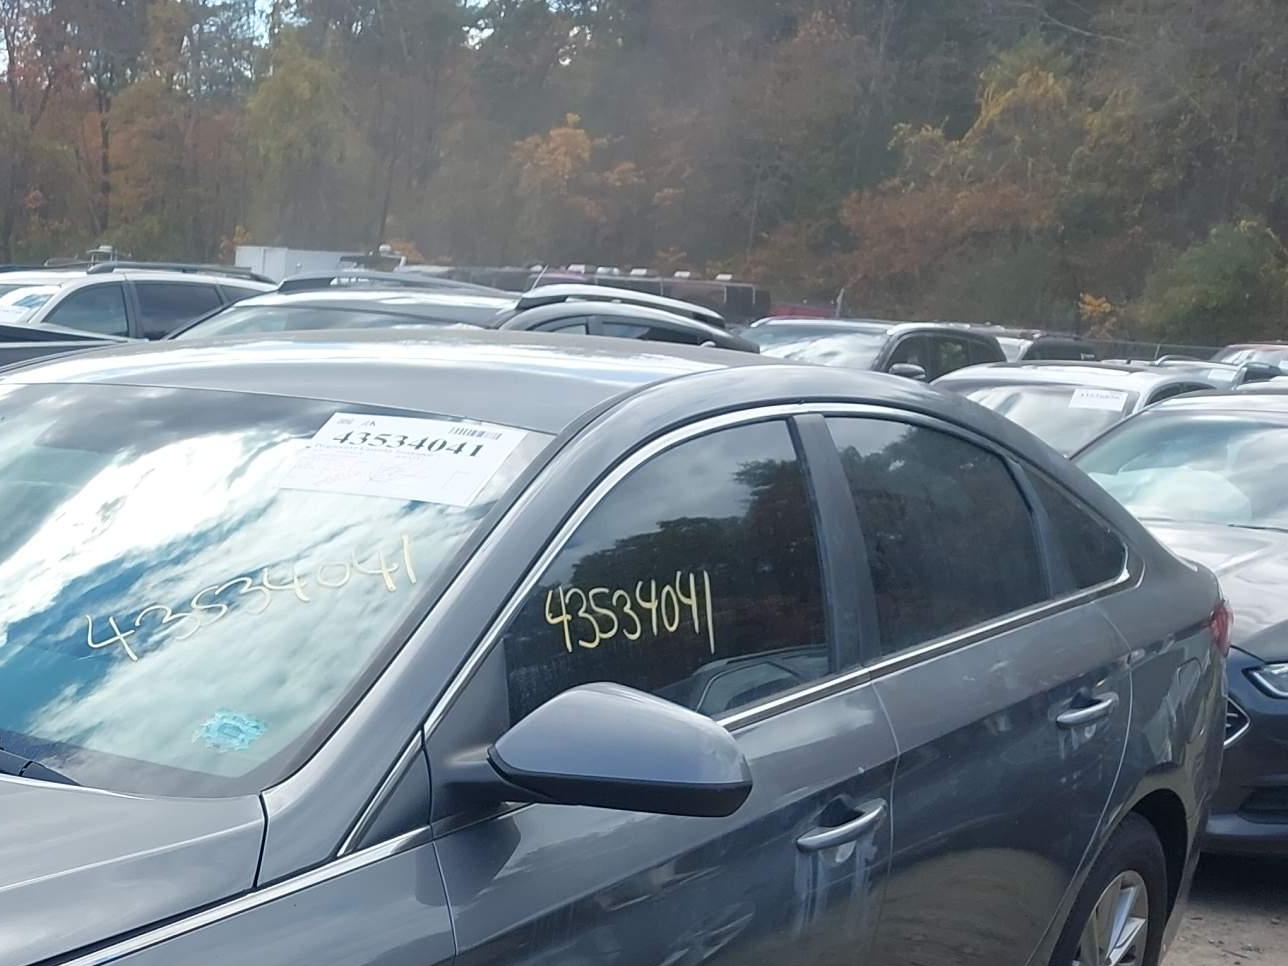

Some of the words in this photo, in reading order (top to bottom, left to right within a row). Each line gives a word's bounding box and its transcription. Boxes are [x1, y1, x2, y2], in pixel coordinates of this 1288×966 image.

[332, 430, 483, 457] 43534041
[86, 535, 417, 662] 43534041
[545, 570, 714, 654] 43534041
